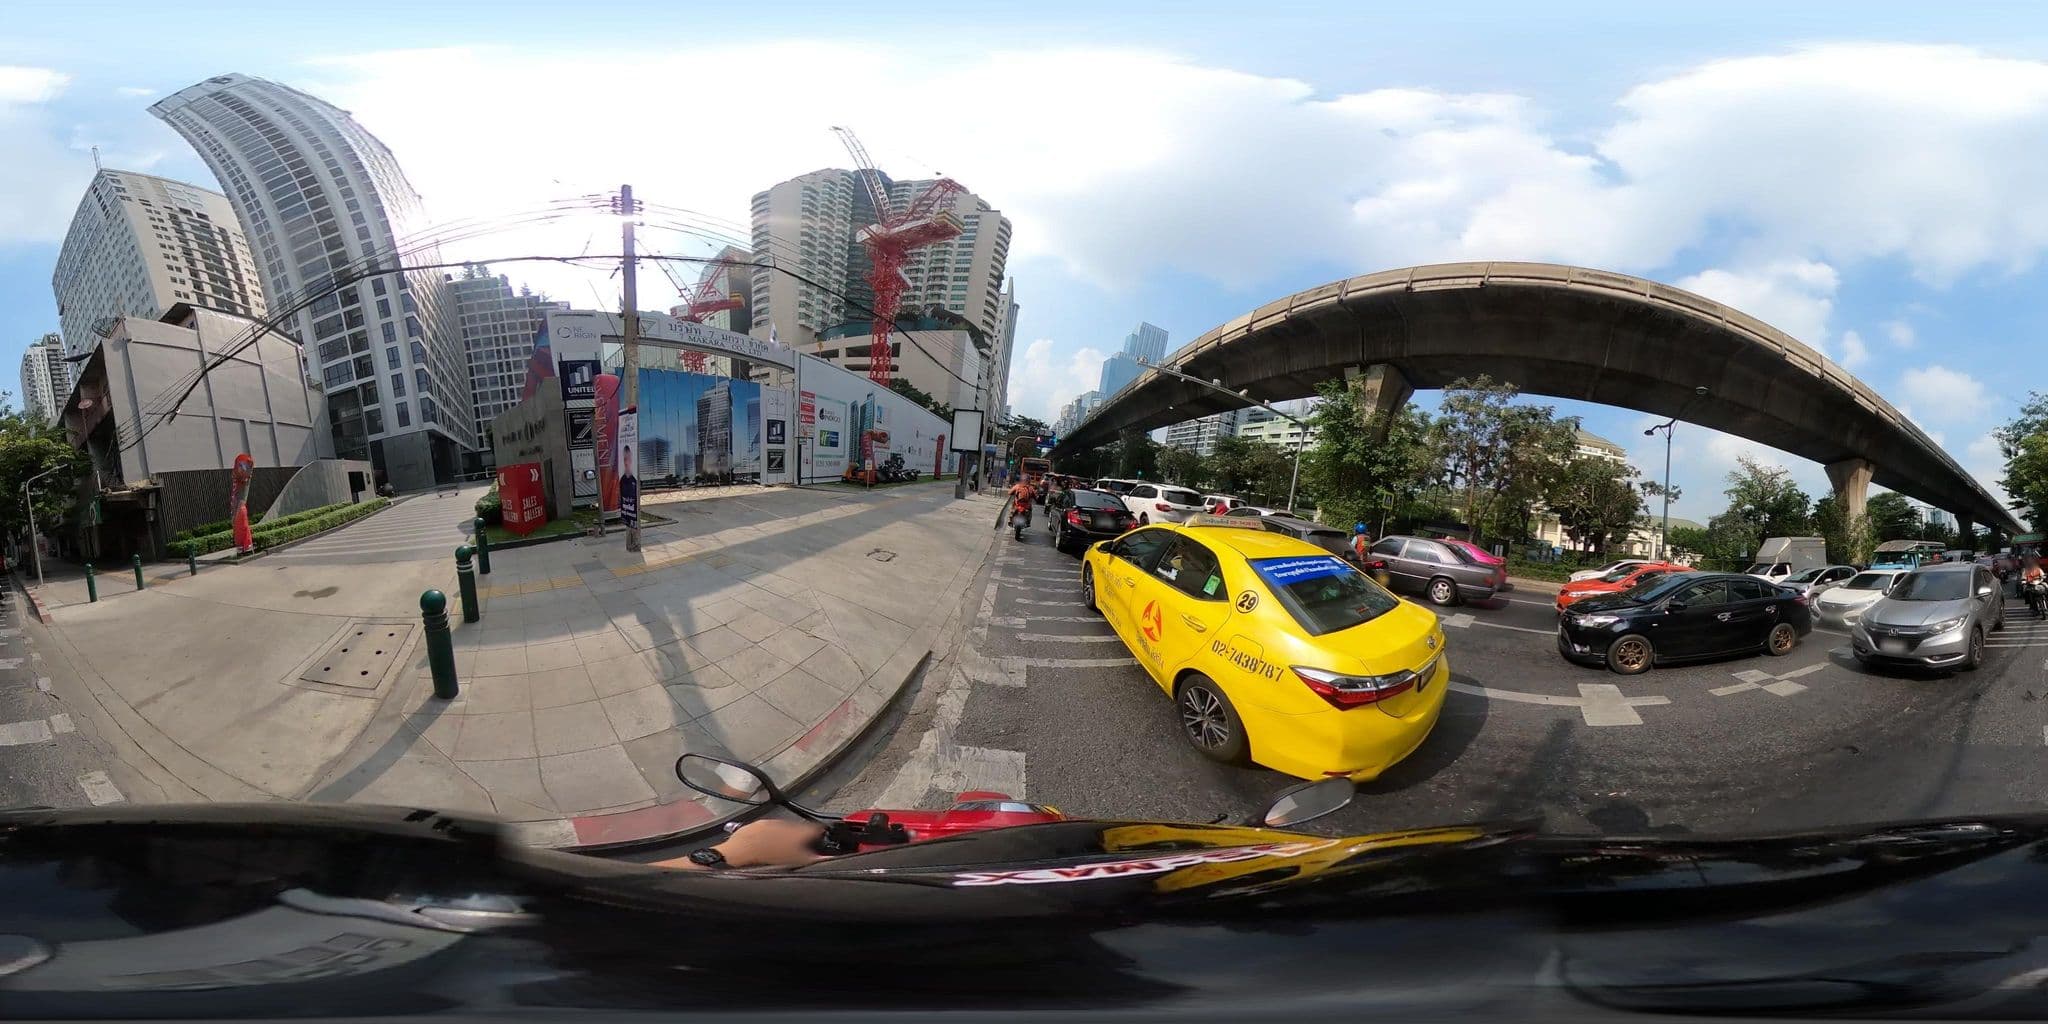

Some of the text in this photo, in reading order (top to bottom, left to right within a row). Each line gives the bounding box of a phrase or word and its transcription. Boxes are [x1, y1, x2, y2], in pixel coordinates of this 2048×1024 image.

[668, 320, 769, 353] บริษัท 7 มกรา จำกัด
[688, 335, 726, 349] MAKARA
[522, 496, 538, 510] SALES
[523, 506, 544, 522] GALLERY
[1237, 593, 1257, 611] 29
[1211, 639, 1285, 682] 02-7438787
